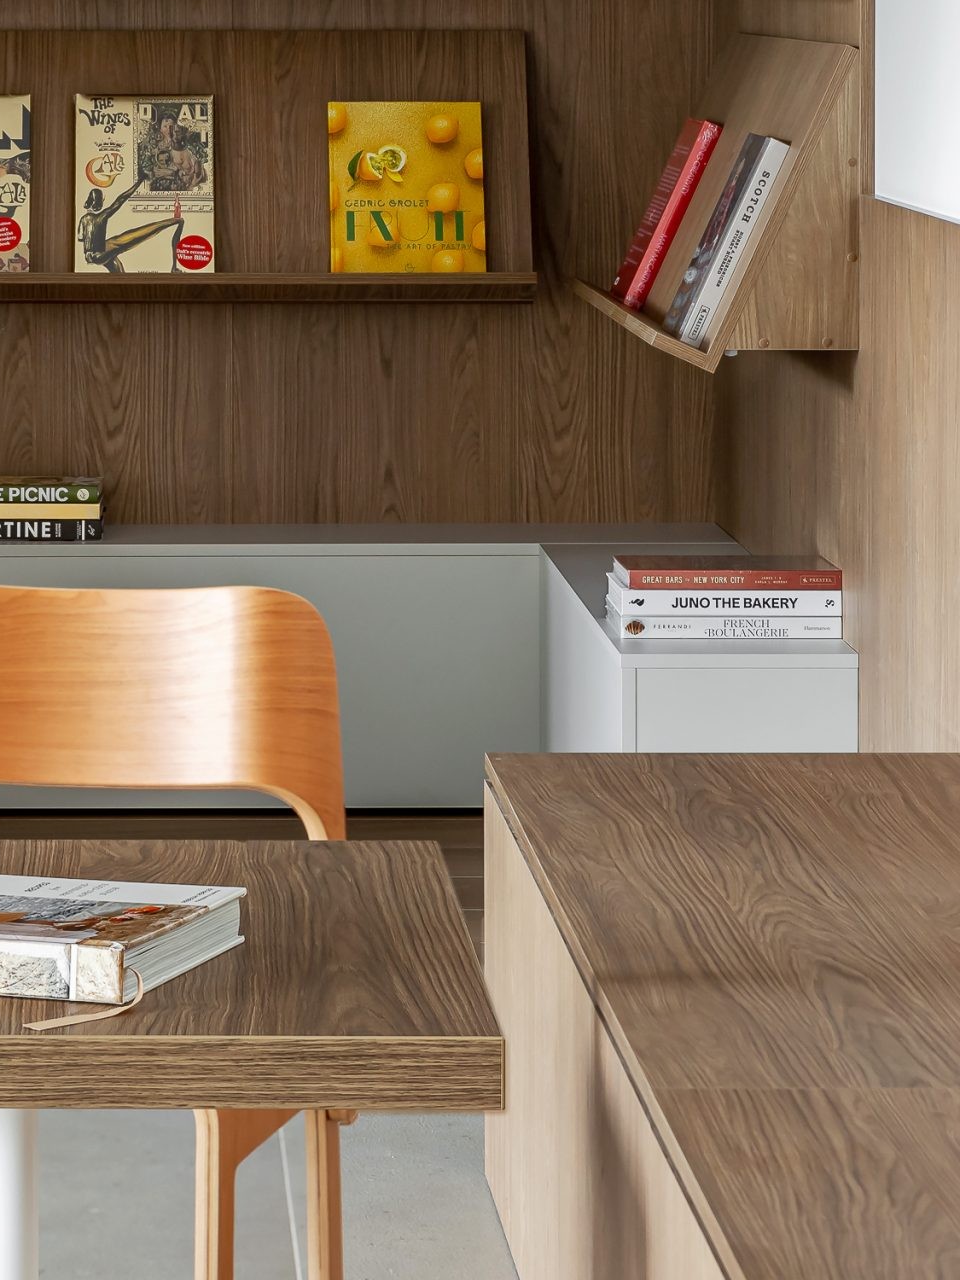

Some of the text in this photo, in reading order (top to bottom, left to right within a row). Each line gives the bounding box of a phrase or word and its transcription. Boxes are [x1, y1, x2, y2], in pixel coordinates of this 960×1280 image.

[90, 97, 114, 110] THE
[78, 108, 131, 127] WINES
[103, 124, 117, 134] OF
[742, 170, 771, 224] SCOTCH
[388, 199, 429, 207] GROLET
[8, 487, 69, 502] PICNIC
[642, 576, 663, 584] GREAT
[665, 576, 683, 584] BARS
[693, 576, 707, 584] NEW
[710, 576, 728, 584] YORK
[730, 576, 745, 584] CITY
[671, 597, 799, 609] JUNO THE BAKERY
[723, 619, 770, 628] FRENCH
[704, 628, 789, 638] BOULANGERIE
